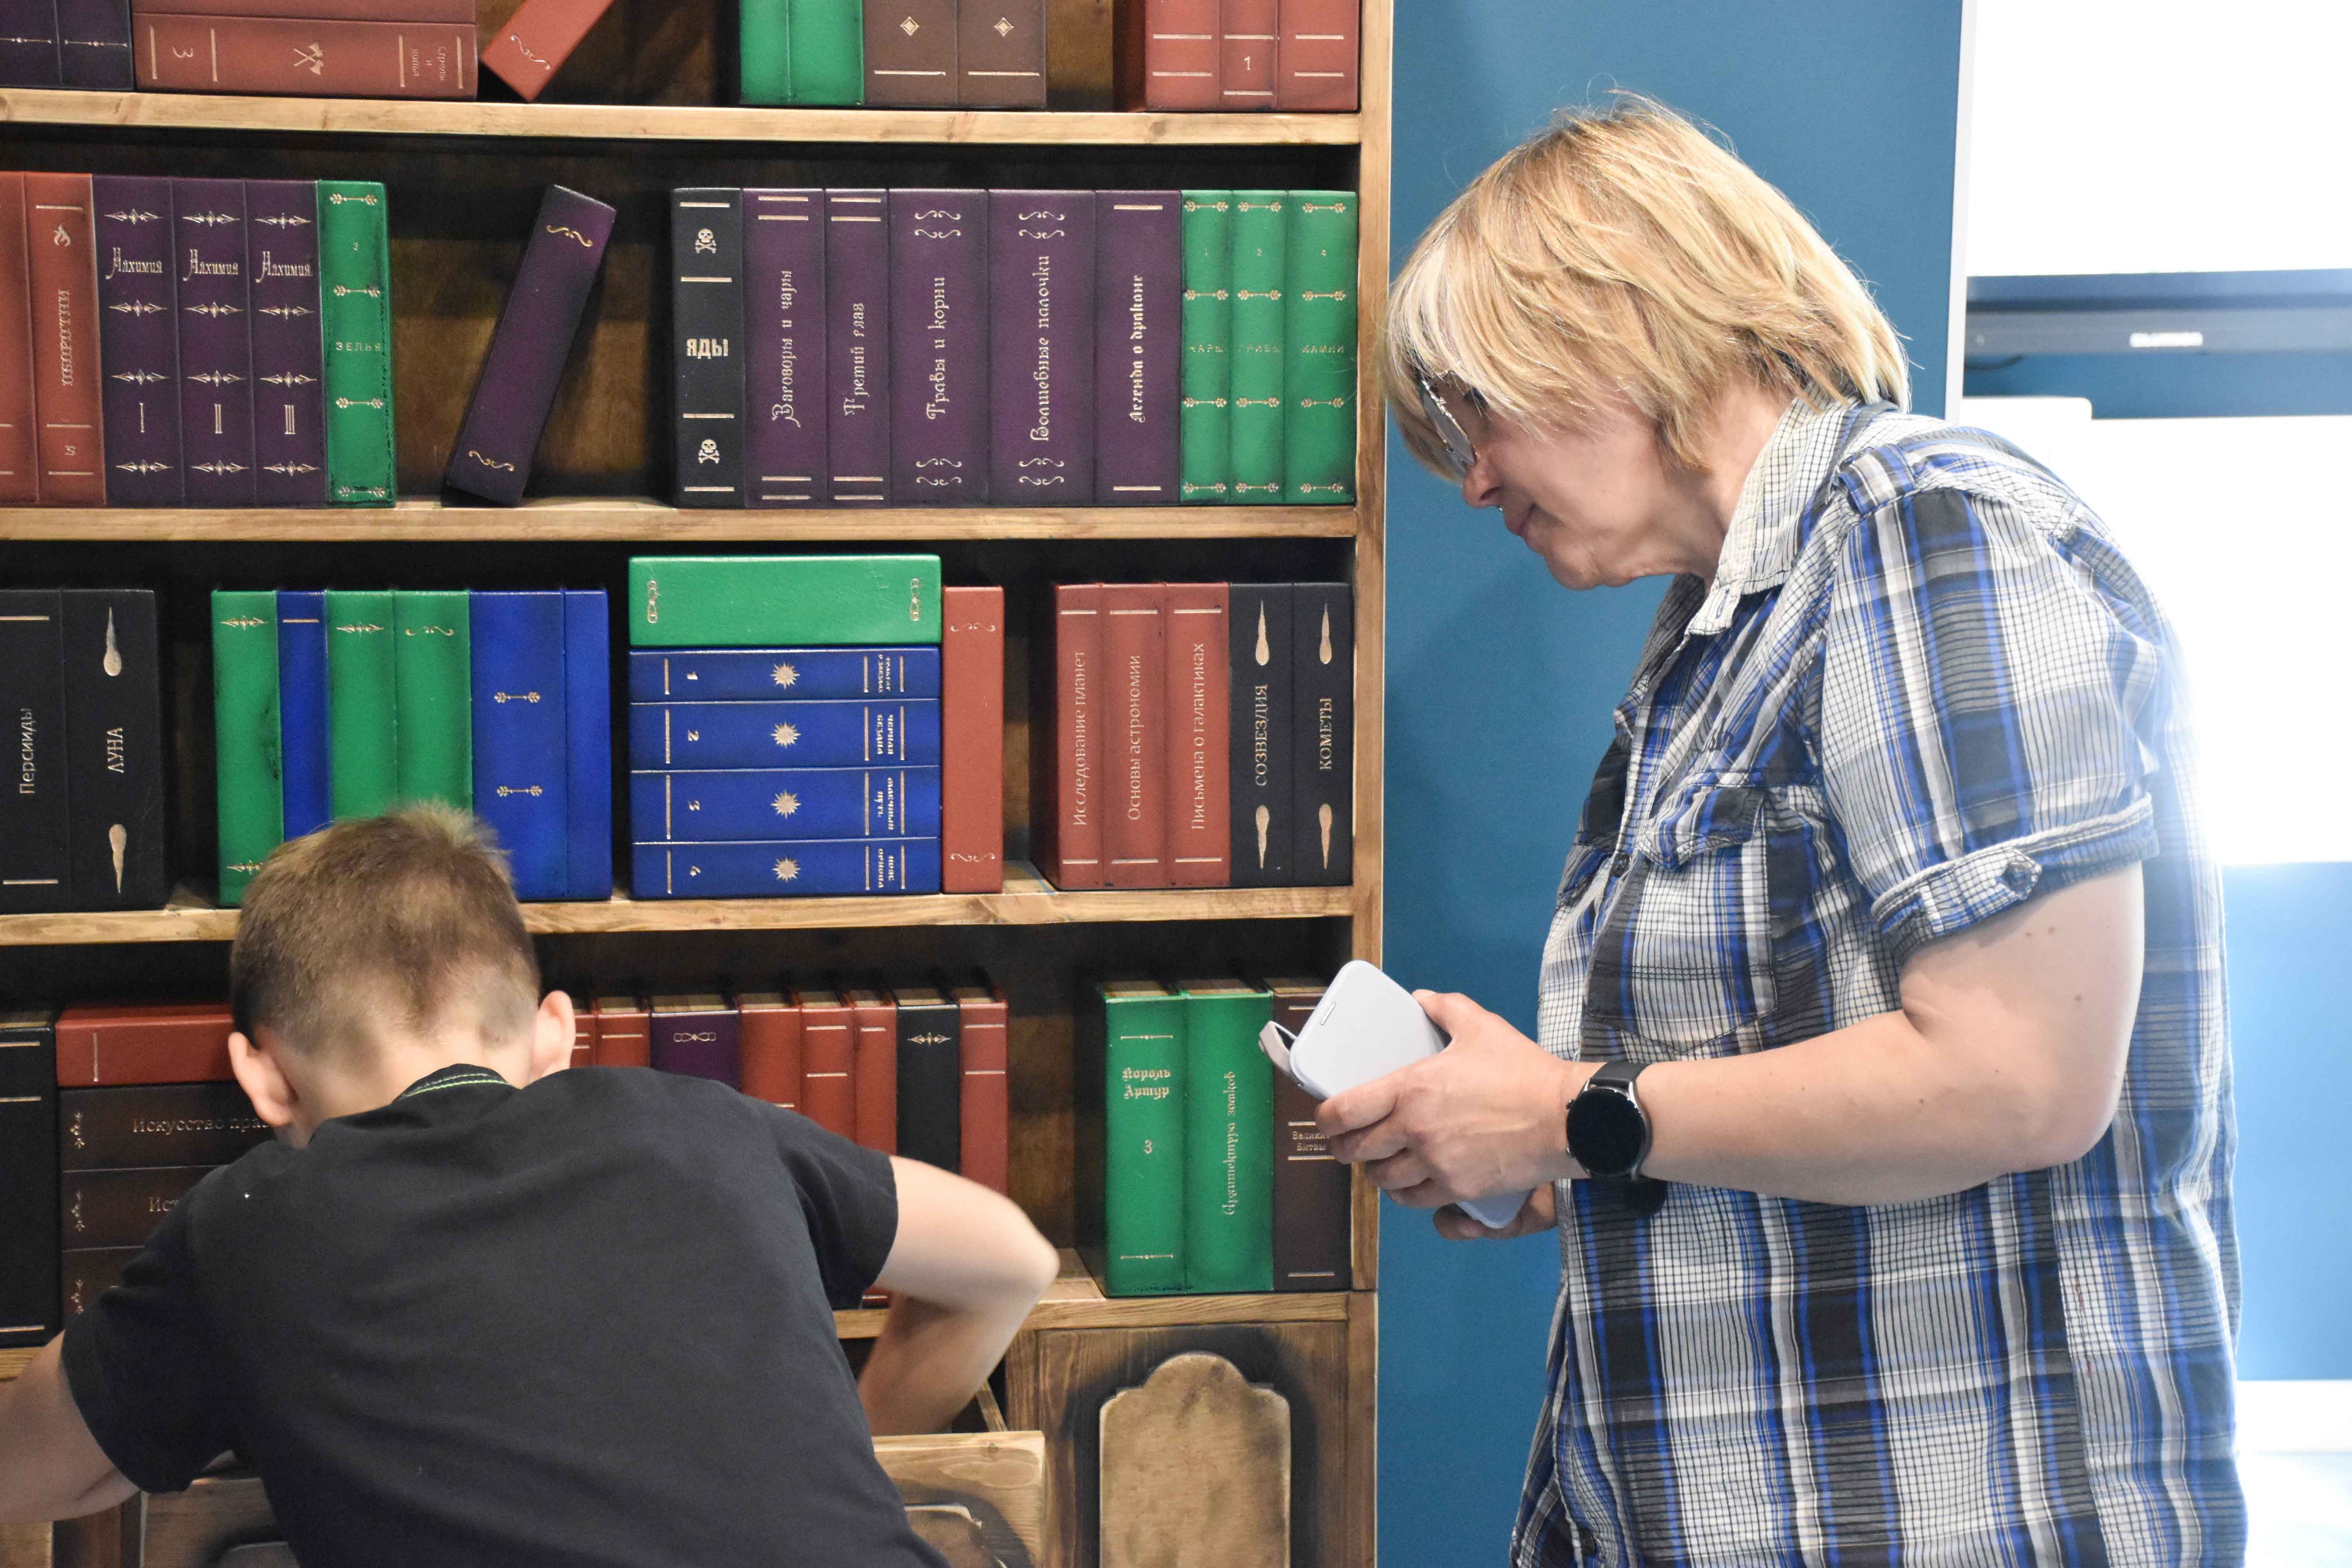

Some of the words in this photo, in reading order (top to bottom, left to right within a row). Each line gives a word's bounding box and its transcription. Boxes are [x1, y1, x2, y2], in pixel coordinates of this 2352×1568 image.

[173, 47, 193, 58] 3
[1245, 56, 1250, 70] 1
[781, 271, 797, 309] чары
[928, 278, 949, 329] корни
[1033, 256, 1049, 328] палочки
[853, 303, 864, 337] глаз
[336, 342, 380, 351] ЗЕЛЬЯ
[687, 339, 728, 359] ЯДЫ
[935, 339, 945, 348] и
[1303, 345, 1344, 354] КАМНИ
[926, 359, 949, 419] Травы
[1030, 338, 1049, 441] Волшебные
[1075, 653, 1085, 705] планет
[1194, 644, 1204, 731] галактиках
[1130, 656, 1144, 753] астрономии
[107, 728, 124, 773] ЛУНА
[688, 731, 699, 741] 2
[1194, 737, 1203, 746] о
[1255, 685, 1269, 786] СОЗВЕЗДИЯ
[1320, 699, 1332, 769] КОМЕТЫ
[1073, 710, 1091, 824] Исследование
[690, 801, 699, 810] 3
[1128, 759, 1140, 820] Основы
[1192, 752, 1204, 829] Письмена
[690, 866, 701, 876] 4
[1145, 1140, 1152, 1154] 3
